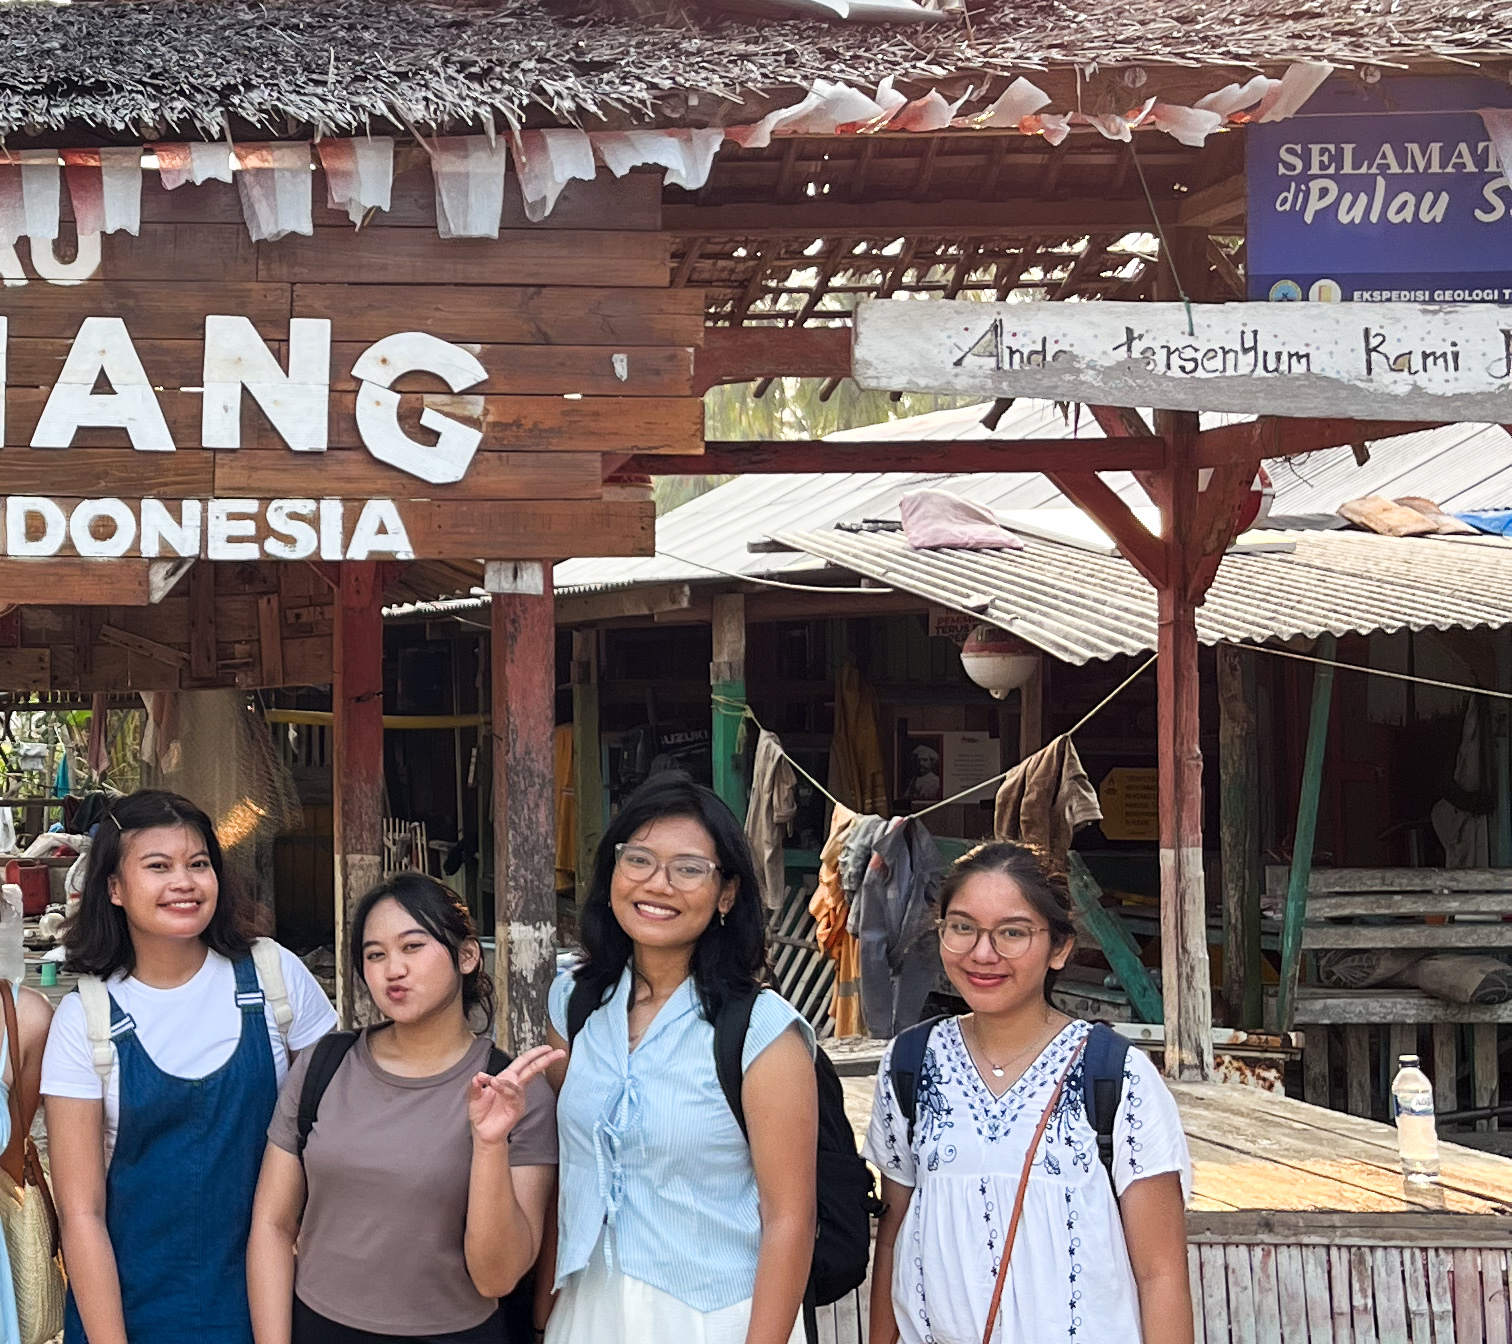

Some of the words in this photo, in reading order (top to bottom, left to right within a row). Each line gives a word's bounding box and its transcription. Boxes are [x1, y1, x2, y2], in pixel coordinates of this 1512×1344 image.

[1278, 141, 1502, 176] SELAMAT
[1352, 290, 1429, 302] EKSPEDISI
[1433, 289, 1499, 301] GEOLOGI
[1363, 326, 1460, 376] Kami
